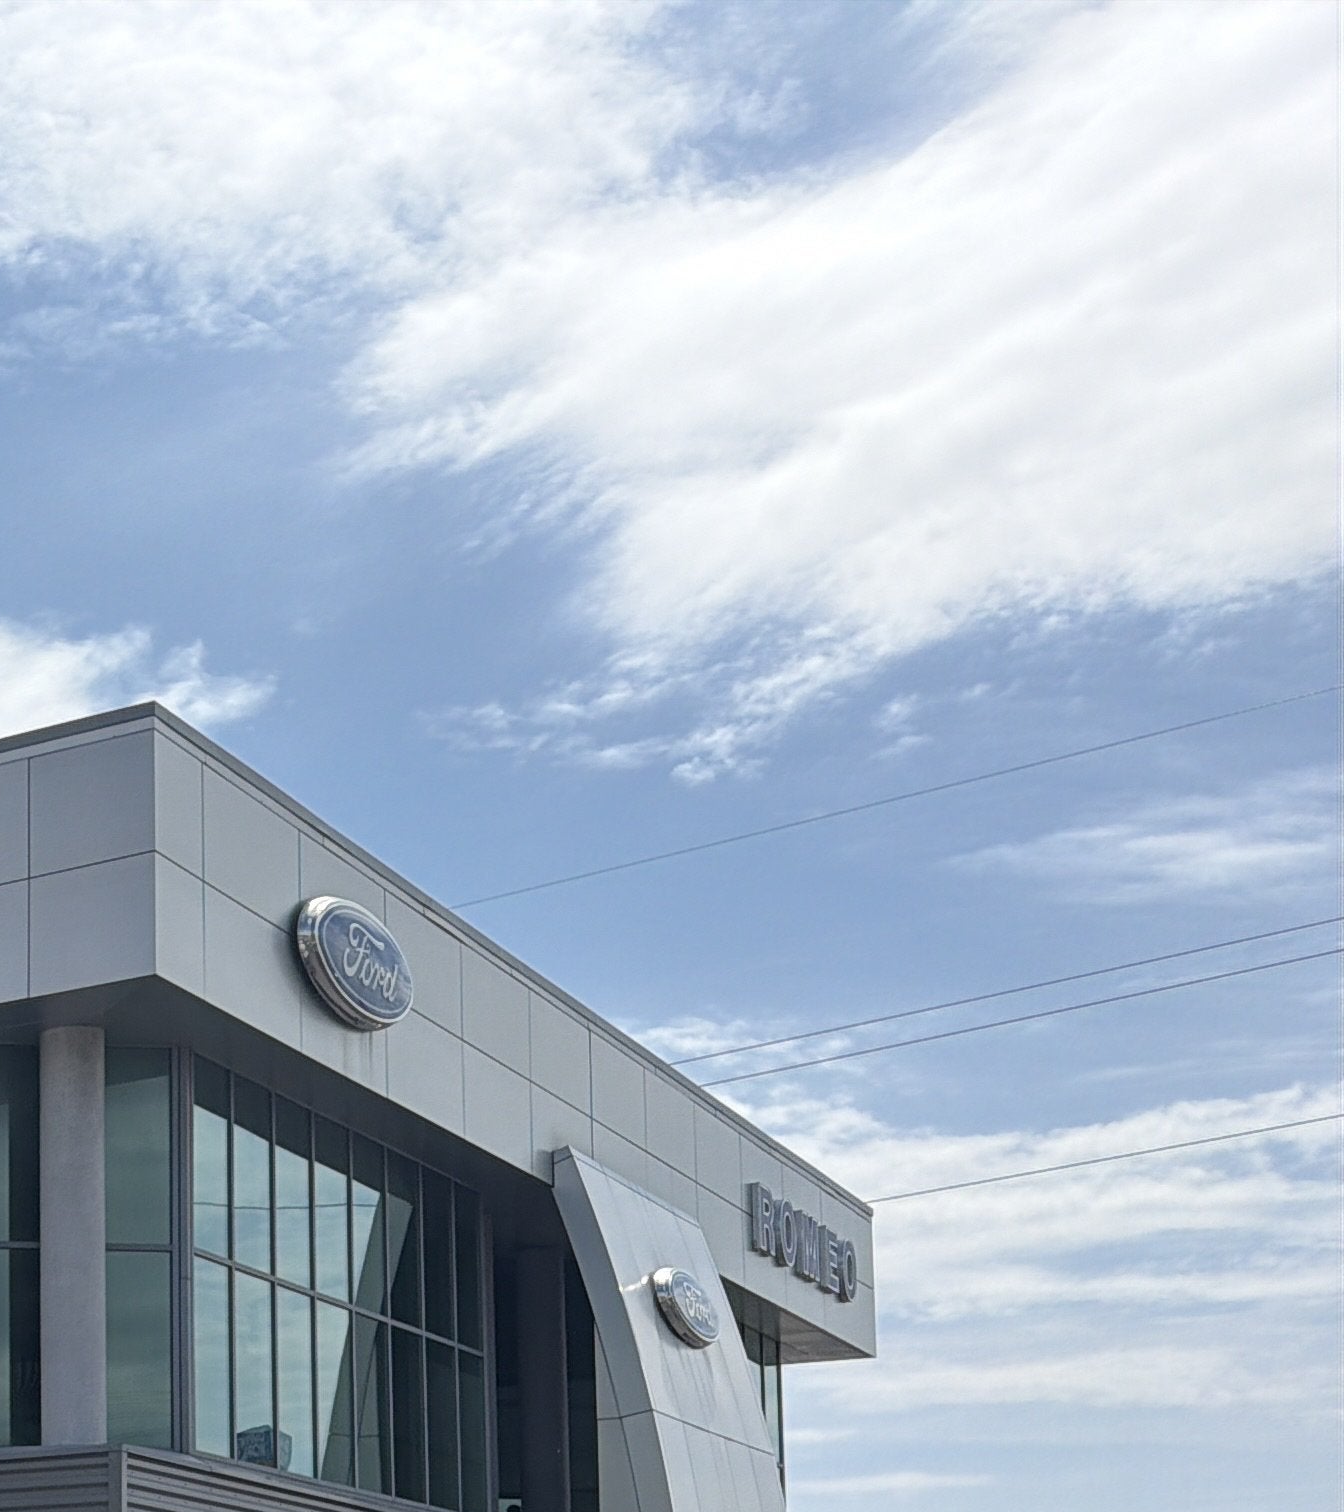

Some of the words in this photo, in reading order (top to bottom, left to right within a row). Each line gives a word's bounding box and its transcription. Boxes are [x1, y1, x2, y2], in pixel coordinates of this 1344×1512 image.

[343, 922, 399, 1001] Ford
[749, 1182, 857, 1302] ROMEO
[683, 1281, 714, 1327] Ford
